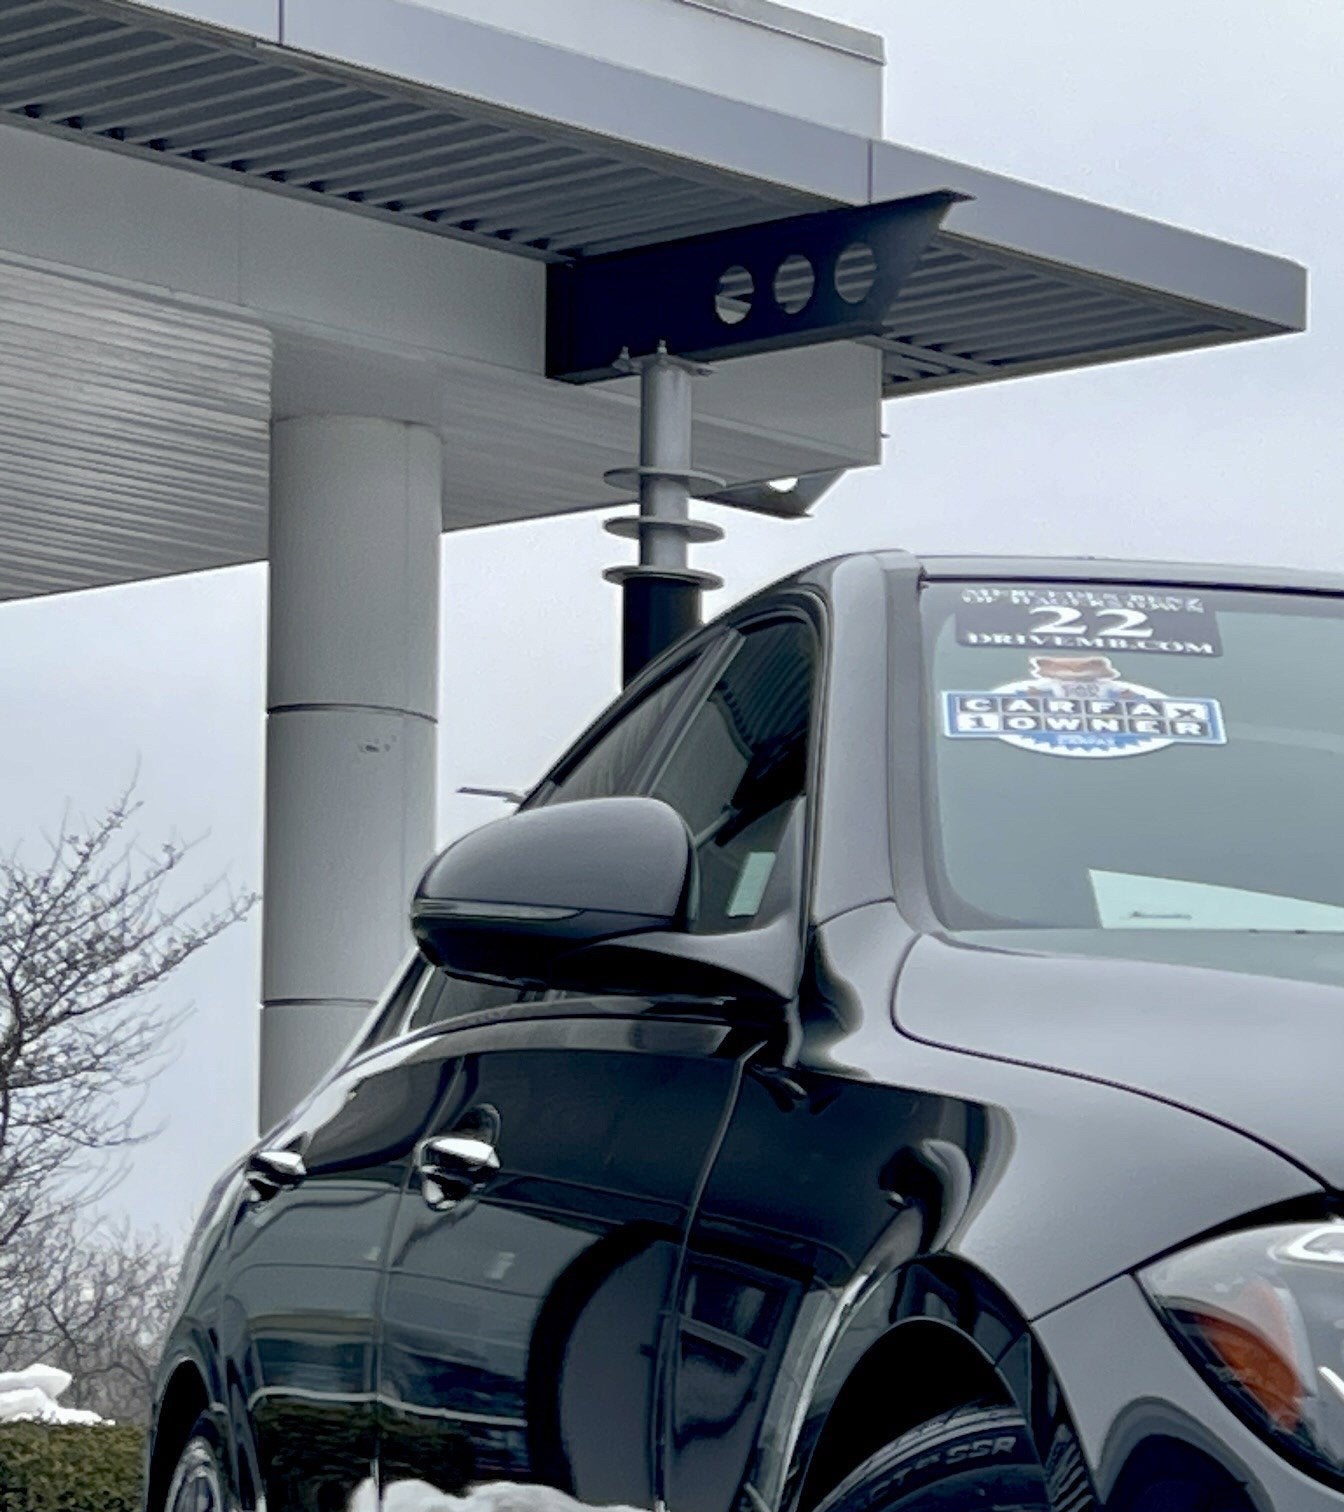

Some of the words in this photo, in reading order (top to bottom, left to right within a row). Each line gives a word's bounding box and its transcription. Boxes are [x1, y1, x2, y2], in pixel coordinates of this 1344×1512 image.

[1029, 605, 1154, 638] 22
[967, 632, 1214, 654] DRIVEMB.COM
[965, 699, 1200, 719] CARFAX
[970, 714, 990, 730] 1
[1007, 715, 1203, 736] OWNER
